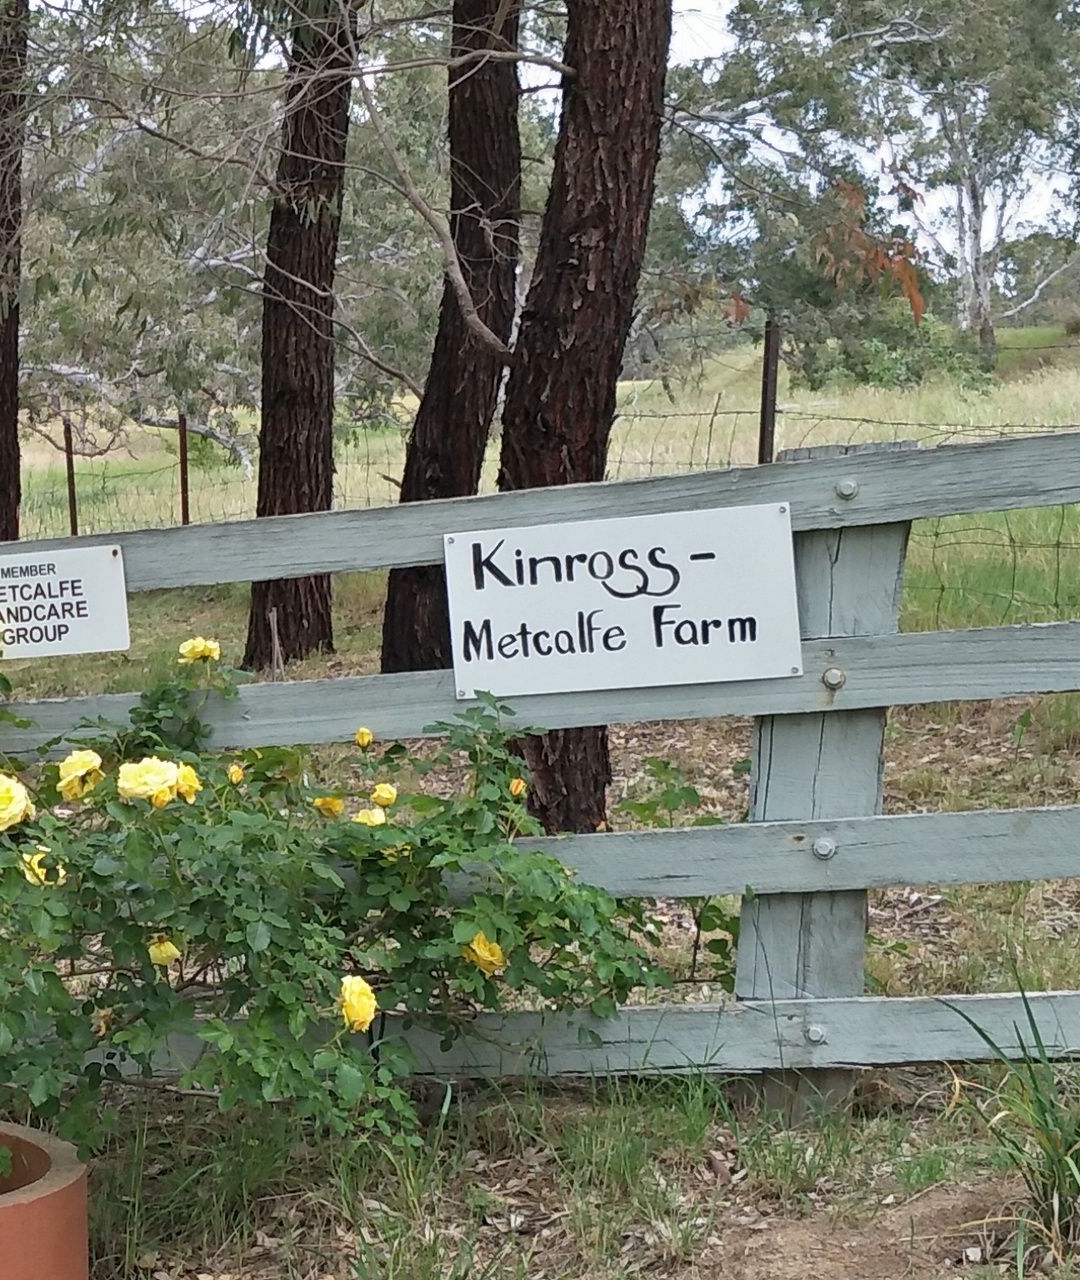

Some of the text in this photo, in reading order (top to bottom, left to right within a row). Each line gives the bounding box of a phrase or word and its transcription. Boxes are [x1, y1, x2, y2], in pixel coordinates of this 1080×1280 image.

[0, 563, 57, 580] MEMBER
[2, 624, 70, 646] GROUP
[462, 603, 758, 663] Metcalfe Farm
